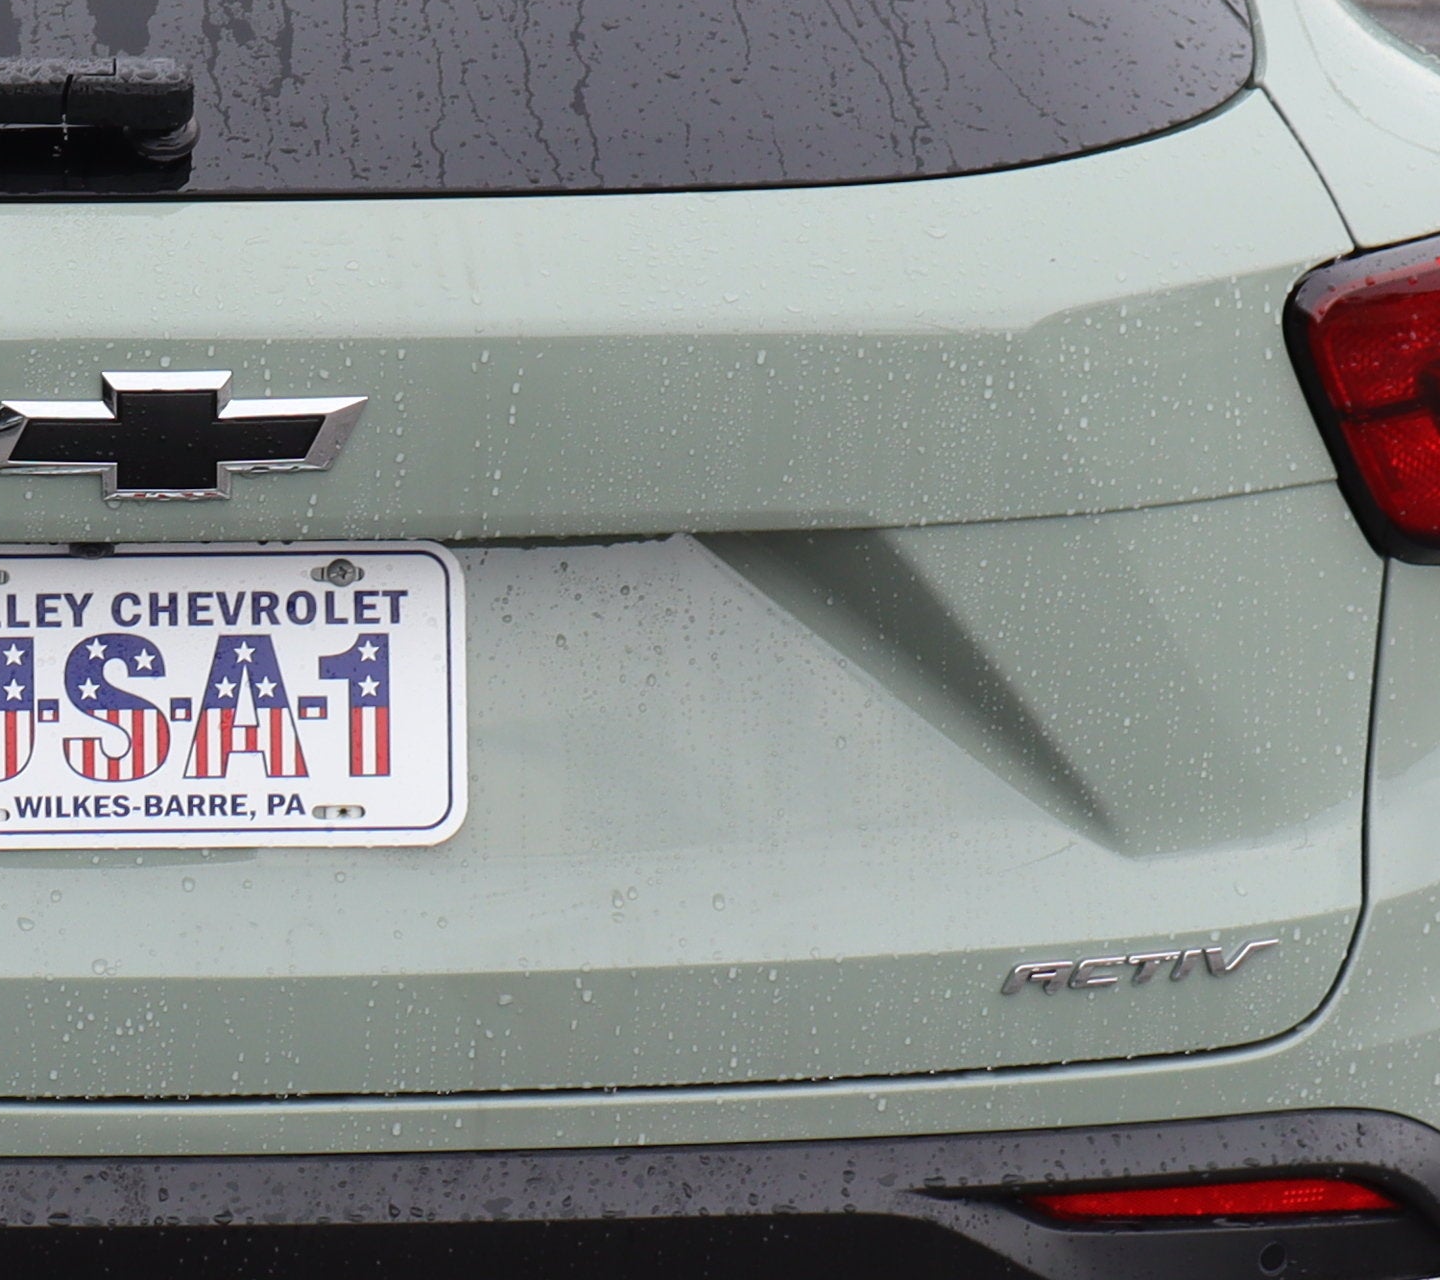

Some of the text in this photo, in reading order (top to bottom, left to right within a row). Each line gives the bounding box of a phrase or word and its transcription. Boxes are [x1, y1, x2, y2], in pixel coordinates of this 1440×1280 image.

[111, 589, 409, 626] CHEVROLET
[14, 792, 307, 821] WILKES-BARRE, PA
[1001, 938, 1280, 996] ACTIV
